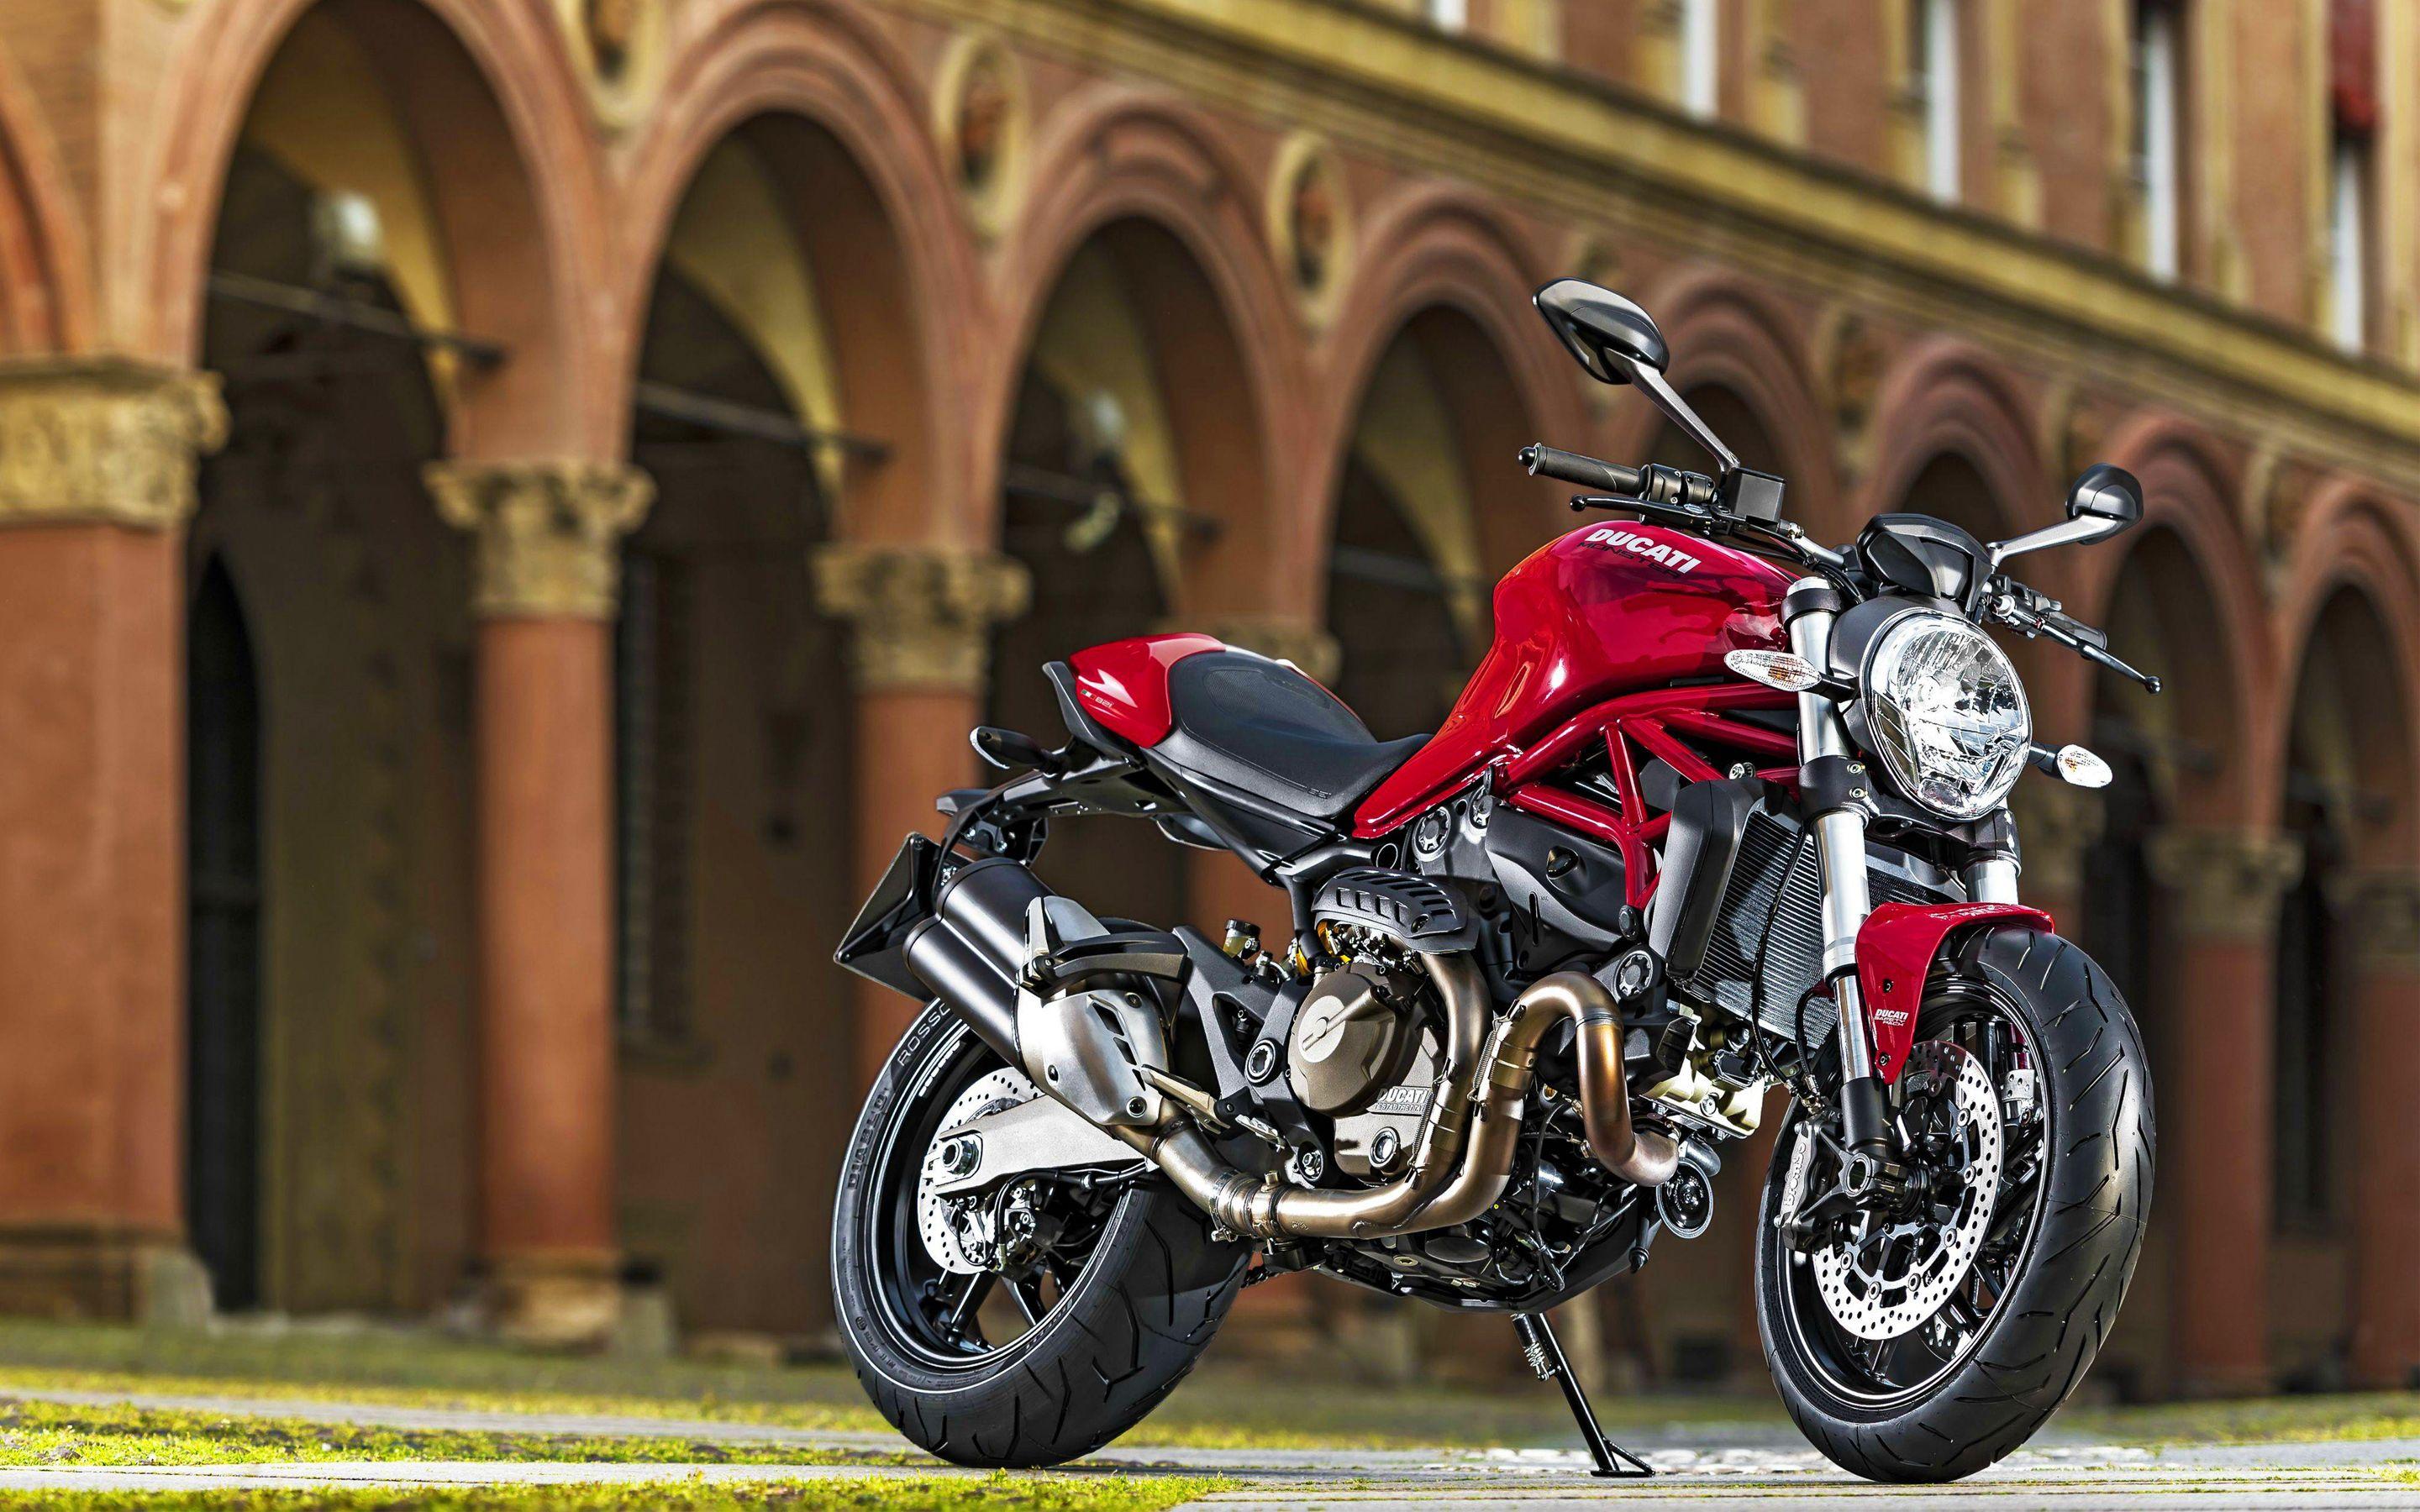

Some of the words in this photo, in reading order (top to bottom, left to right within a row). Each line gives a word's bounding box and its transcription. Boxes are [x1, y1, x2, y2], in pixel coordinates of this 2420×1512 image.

[1576, 541, 1680, 578] MONSTER
[1585, 528, 1702, 574] DUCATI
[1875, 1008, 1909, 1021] DUCATI
[1376, 1088, 1428, 1104] DUCATI
[847, 1094, 887, 1189] DIABLO
[1782, 1142, 1807, 1207] brembo
